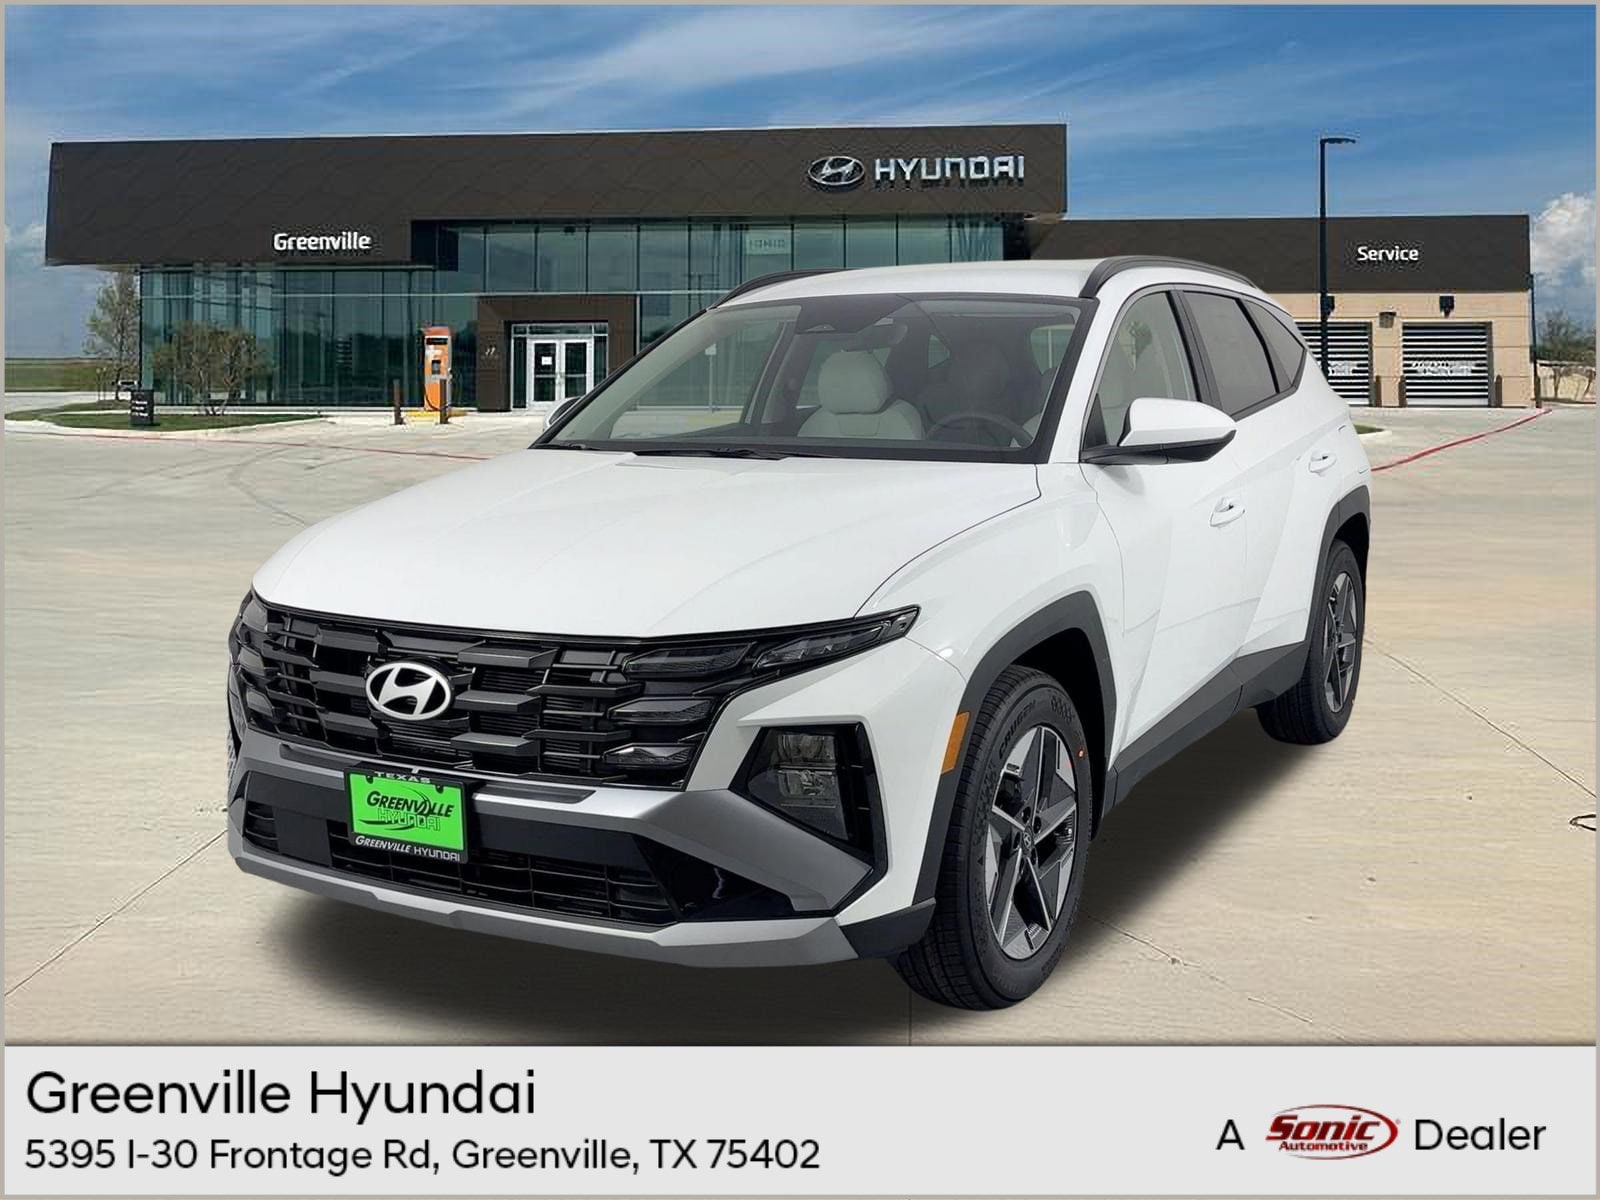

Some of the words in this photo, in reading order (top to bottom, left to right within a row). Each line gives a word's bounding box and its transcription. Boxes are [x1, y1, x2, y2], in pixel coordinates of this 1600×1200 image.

[874, 155, 1025, 181] HYUNDAI
[273, 231, 372, 250] Greenville
[1356, 245, 1419, 261] Service
[374, 770, 431, 784] TEXAS
[366, 790, 455, 818] GREENVILLE
[355, 835, 411, 854] GREENVILLE
[413, 846, 461, 862] HYUNDAI
